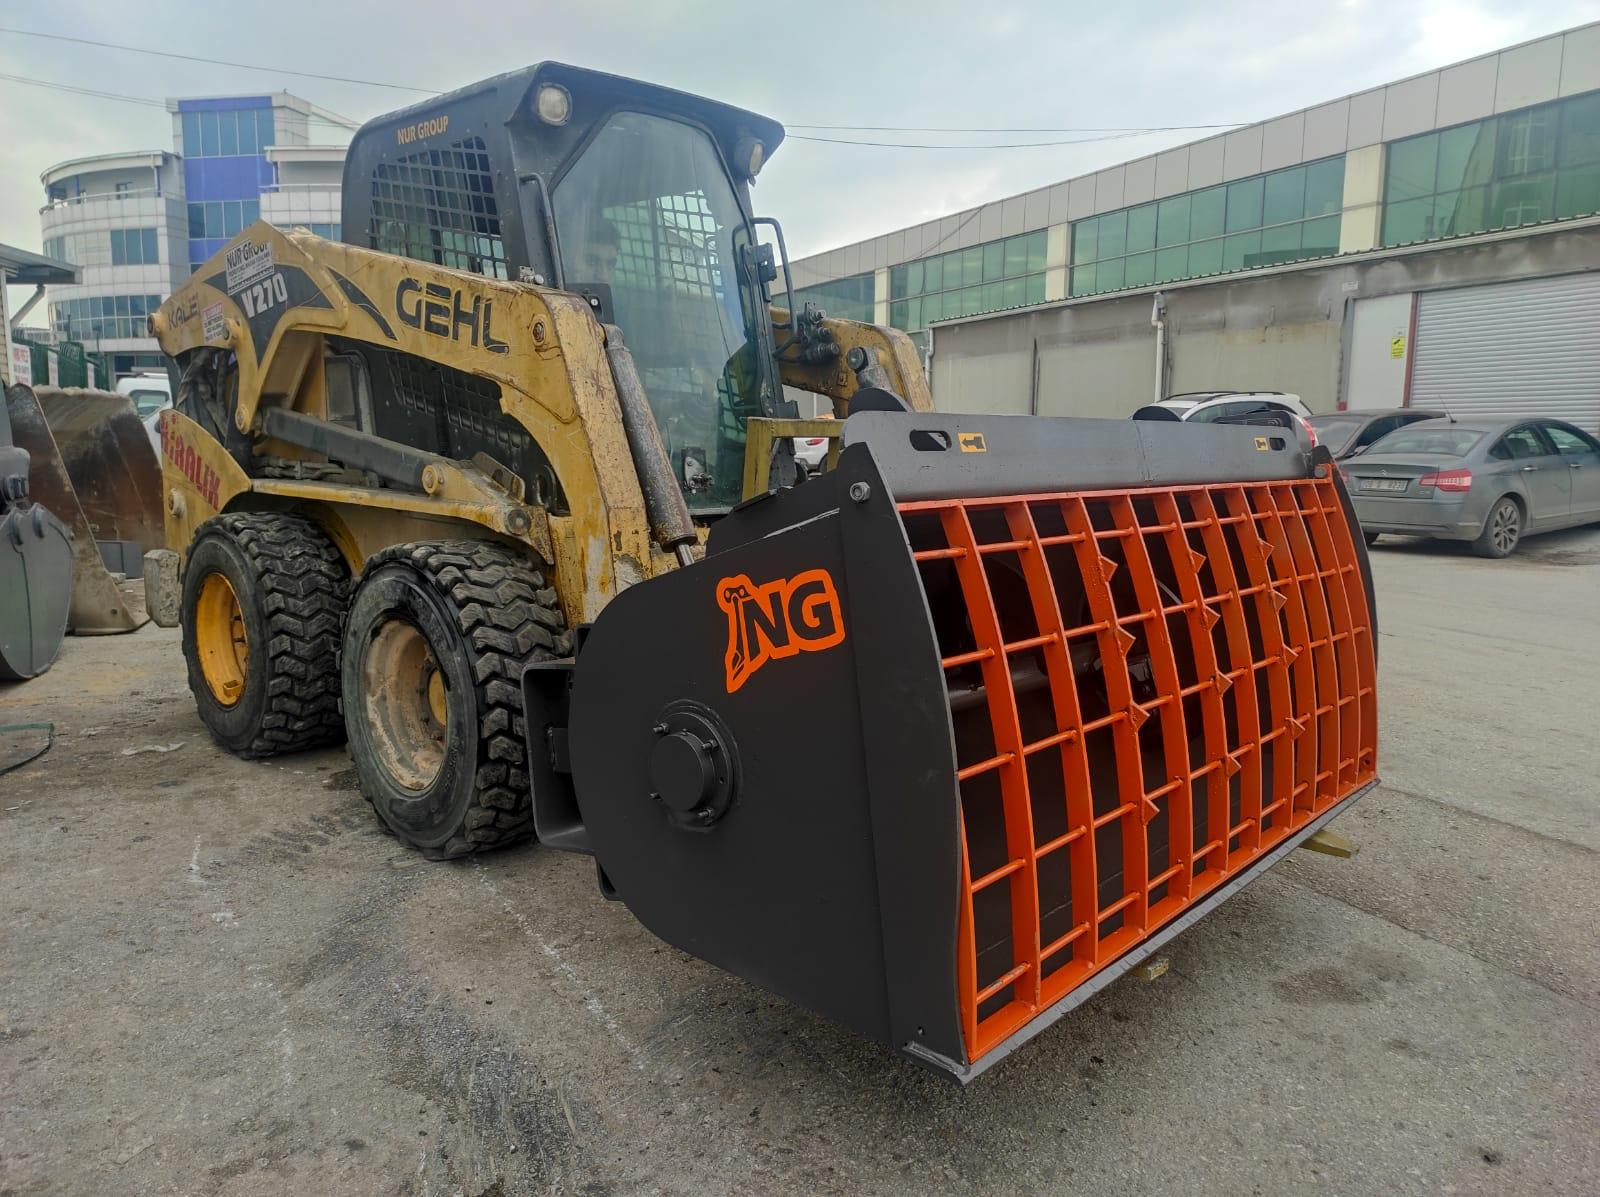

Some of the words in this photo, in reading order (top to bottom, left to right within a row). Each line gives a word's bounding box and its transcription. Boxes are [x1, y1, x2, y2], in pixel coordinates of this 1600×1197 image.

[397, 126, 416, 144] NUR
[418, 115, 449, 139] GROUP
[227, 248, 242, 270] NUR
[241, 272, 288, 318] V270
[396, 277, 509, 354] GEHL
